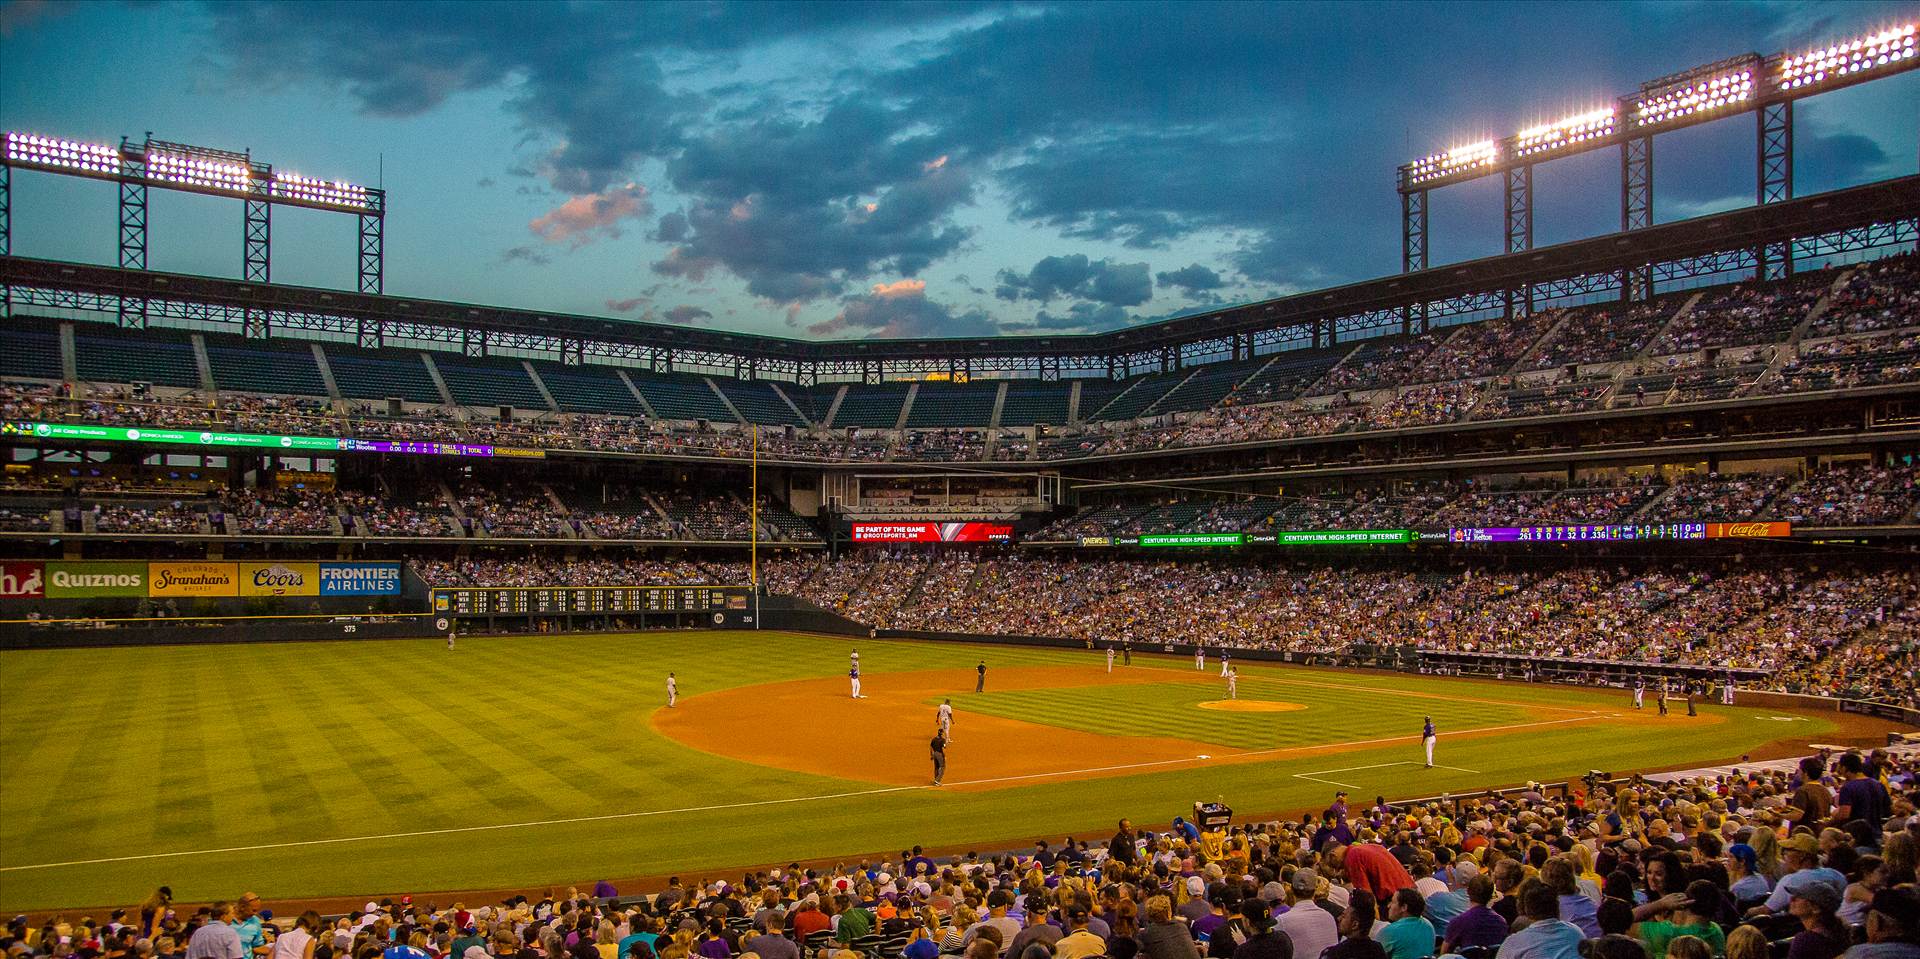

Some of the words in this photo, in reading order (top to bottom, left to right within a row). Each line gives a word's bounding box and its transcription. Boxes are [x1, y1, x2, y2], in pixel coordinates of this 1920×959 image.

[1464, 528, 1471, 537] 17
[1590, 531, 1606, 539] .336
[1729, 523, 1772, 537] Coca-Cola
[1284, 534, 1327, 542] CENTURYLINK
[253, 568, 304, 587] Coors
[320, 568, 399, 579] FRONTIER
[52, 571, 141, 587] Quiznos
[154, 569, 230, 589] Stranahan's
[327, 580, 395, 590] AIRLINES
[344, 625, 356, 633] 375
